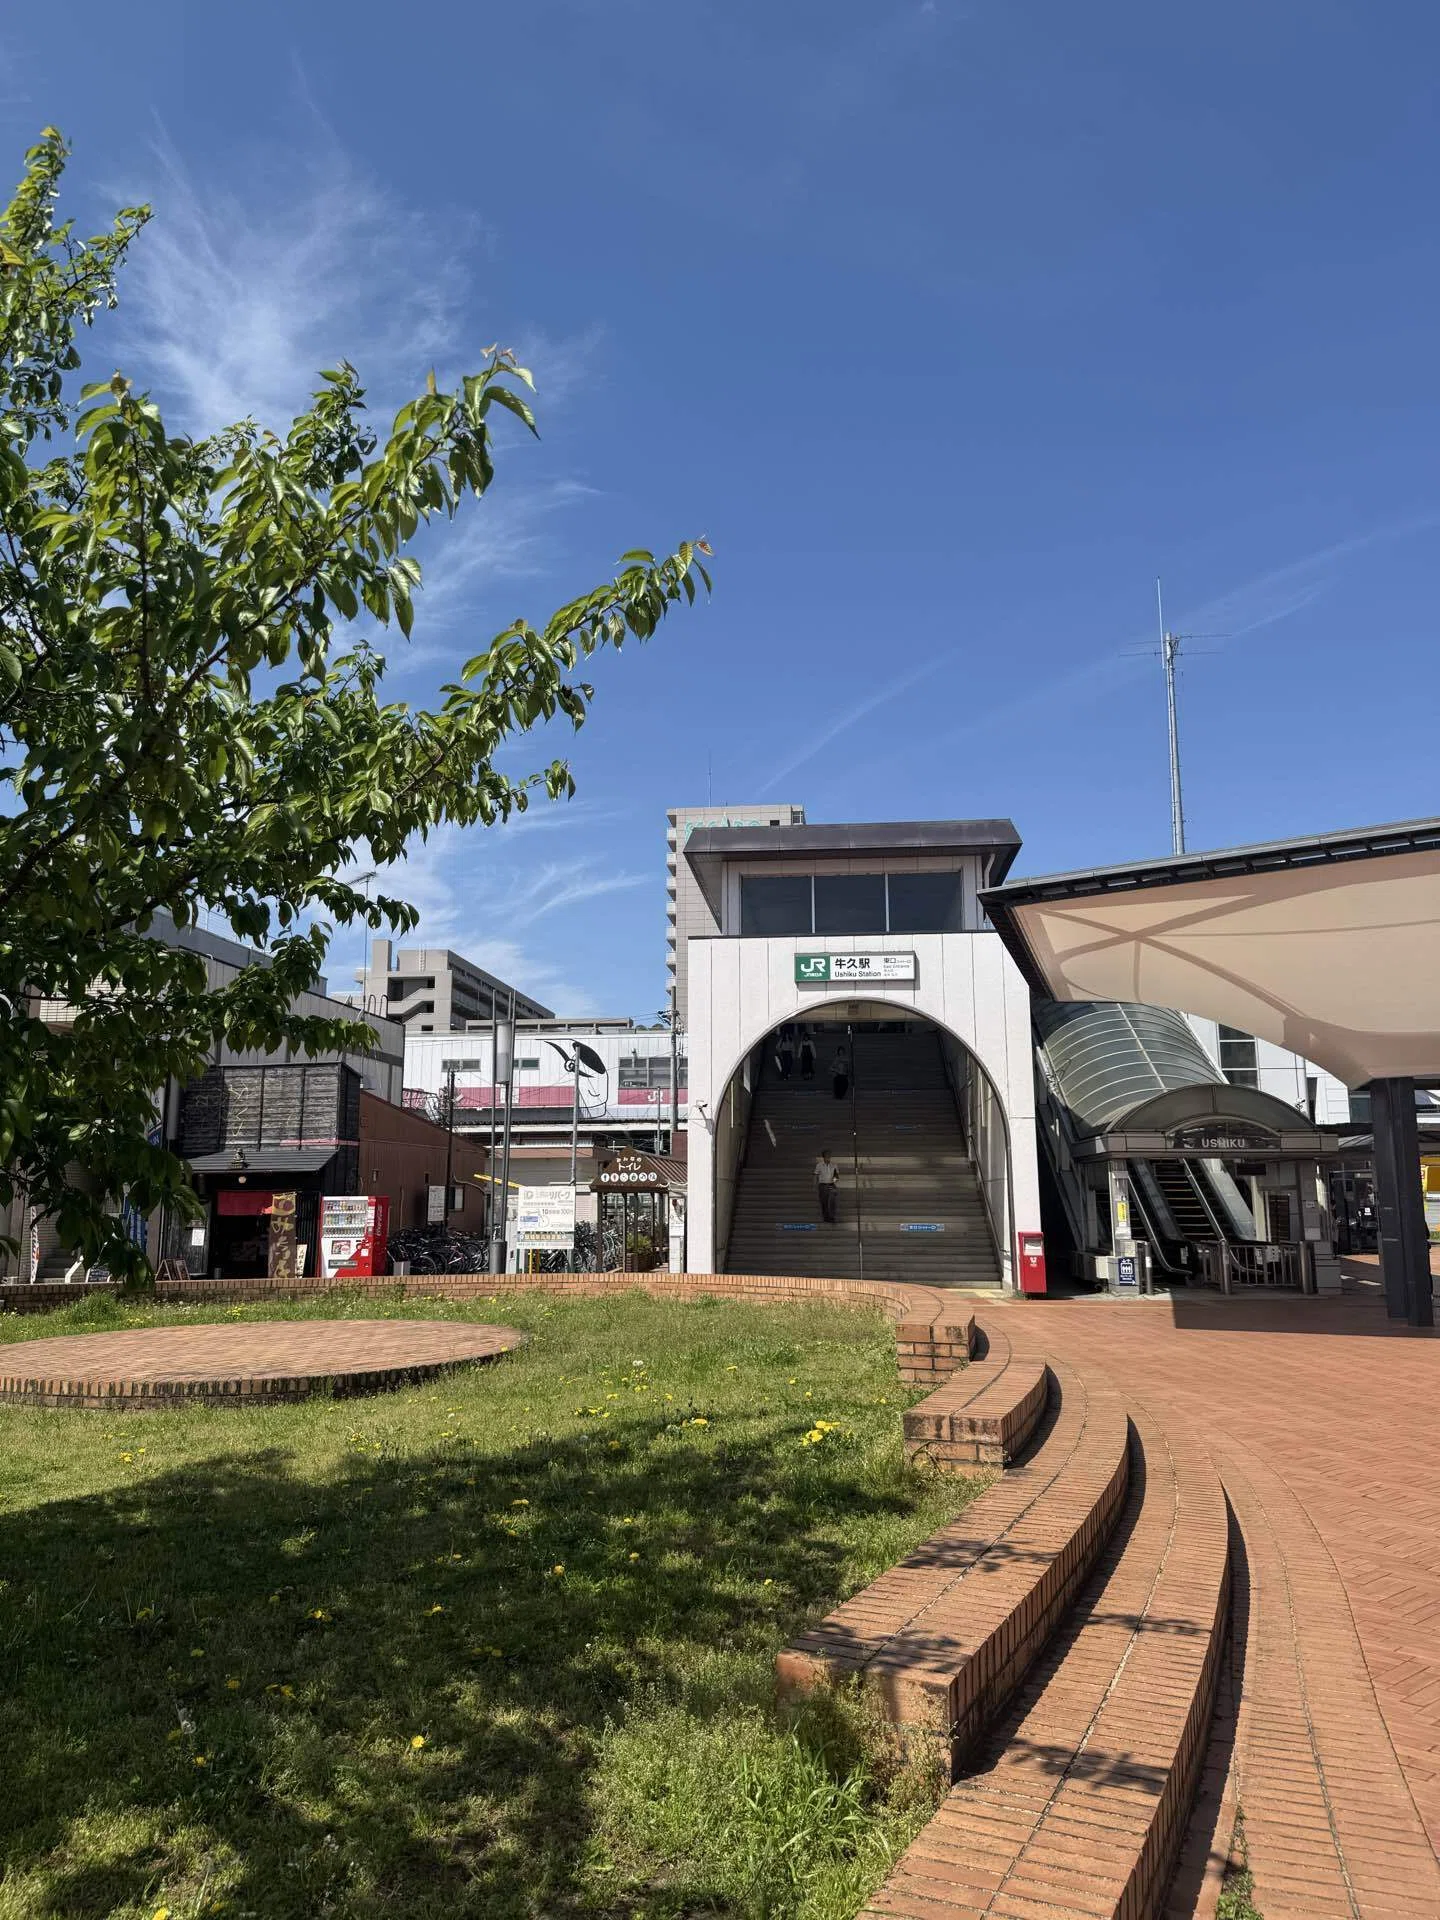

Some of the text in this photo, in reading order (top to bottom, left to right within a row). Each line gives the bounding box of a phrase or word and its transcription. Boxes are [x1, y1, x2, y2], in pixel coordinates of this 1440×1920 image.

[801, 958, 826, 972] JR
[835, 957, 870, 969] 牛久駅
[1201, 1138, 1245, 1148] USHIKU
[618, 1162, 641, 1171] トイレ
